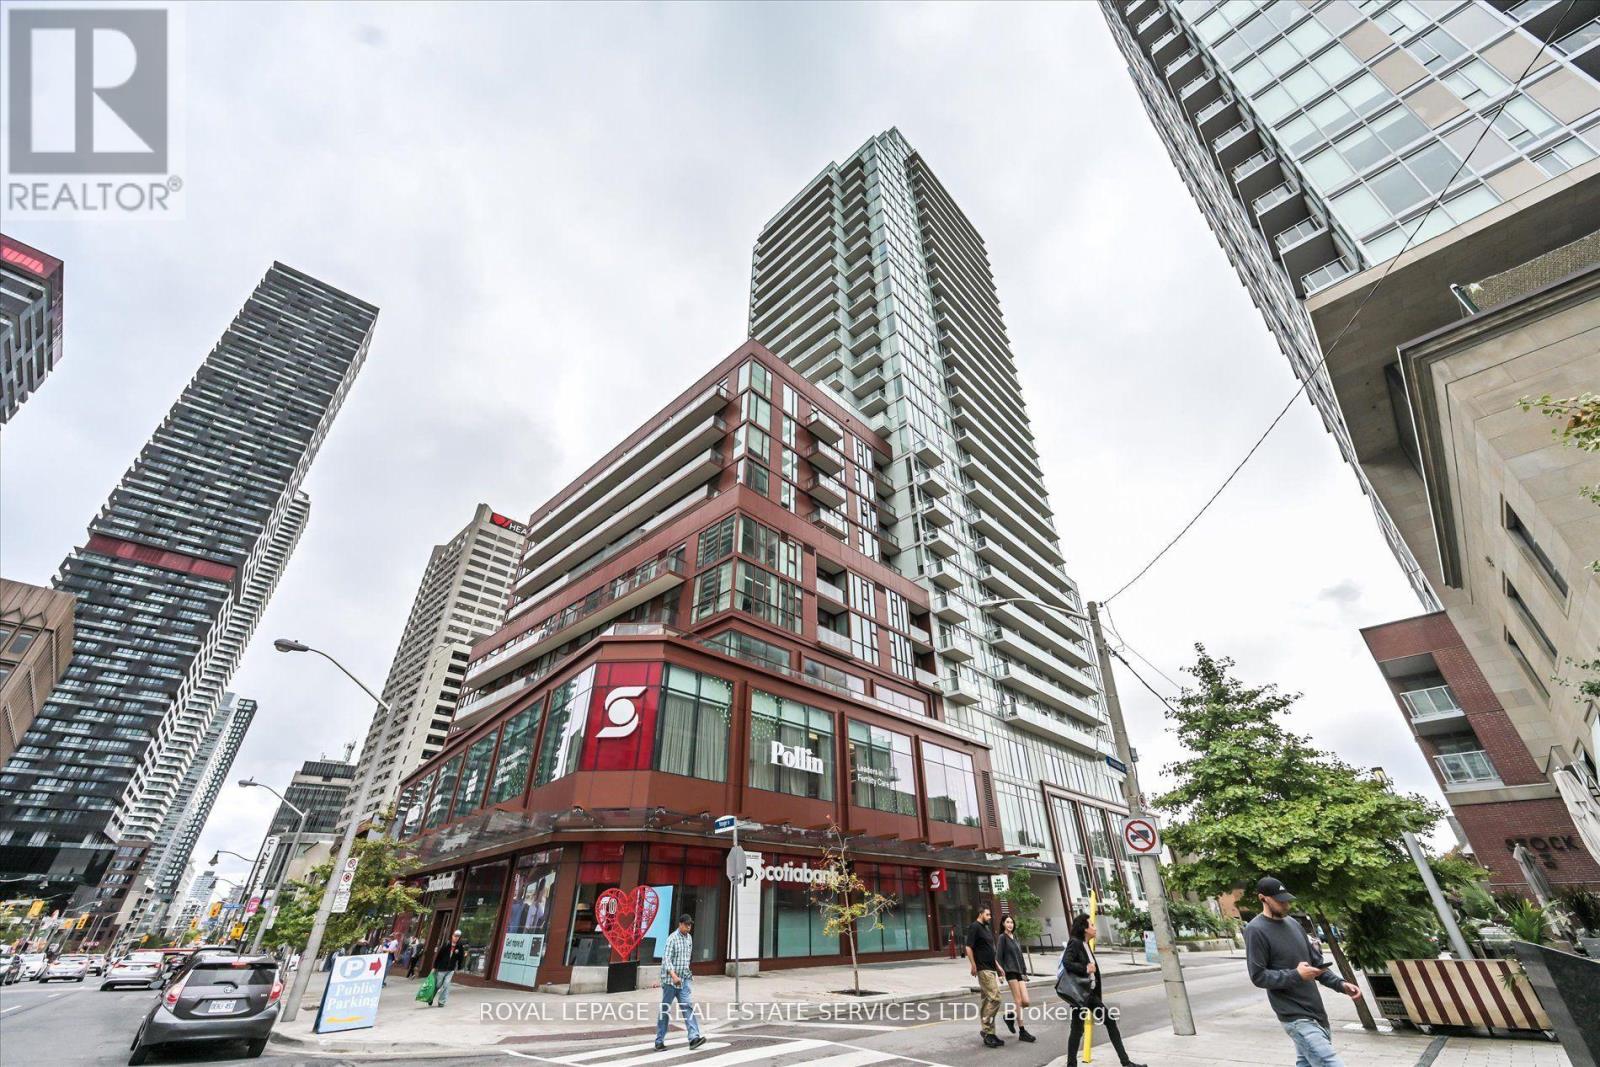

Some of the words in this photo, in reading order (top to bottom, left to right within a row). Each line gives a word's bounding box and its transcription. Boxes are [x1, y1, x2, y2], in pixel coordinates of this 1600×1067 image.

[770, 740, 825, 775] Pollin
[335, 981, 374, 997] Public
[326, 995, 378, 1011] Parking
